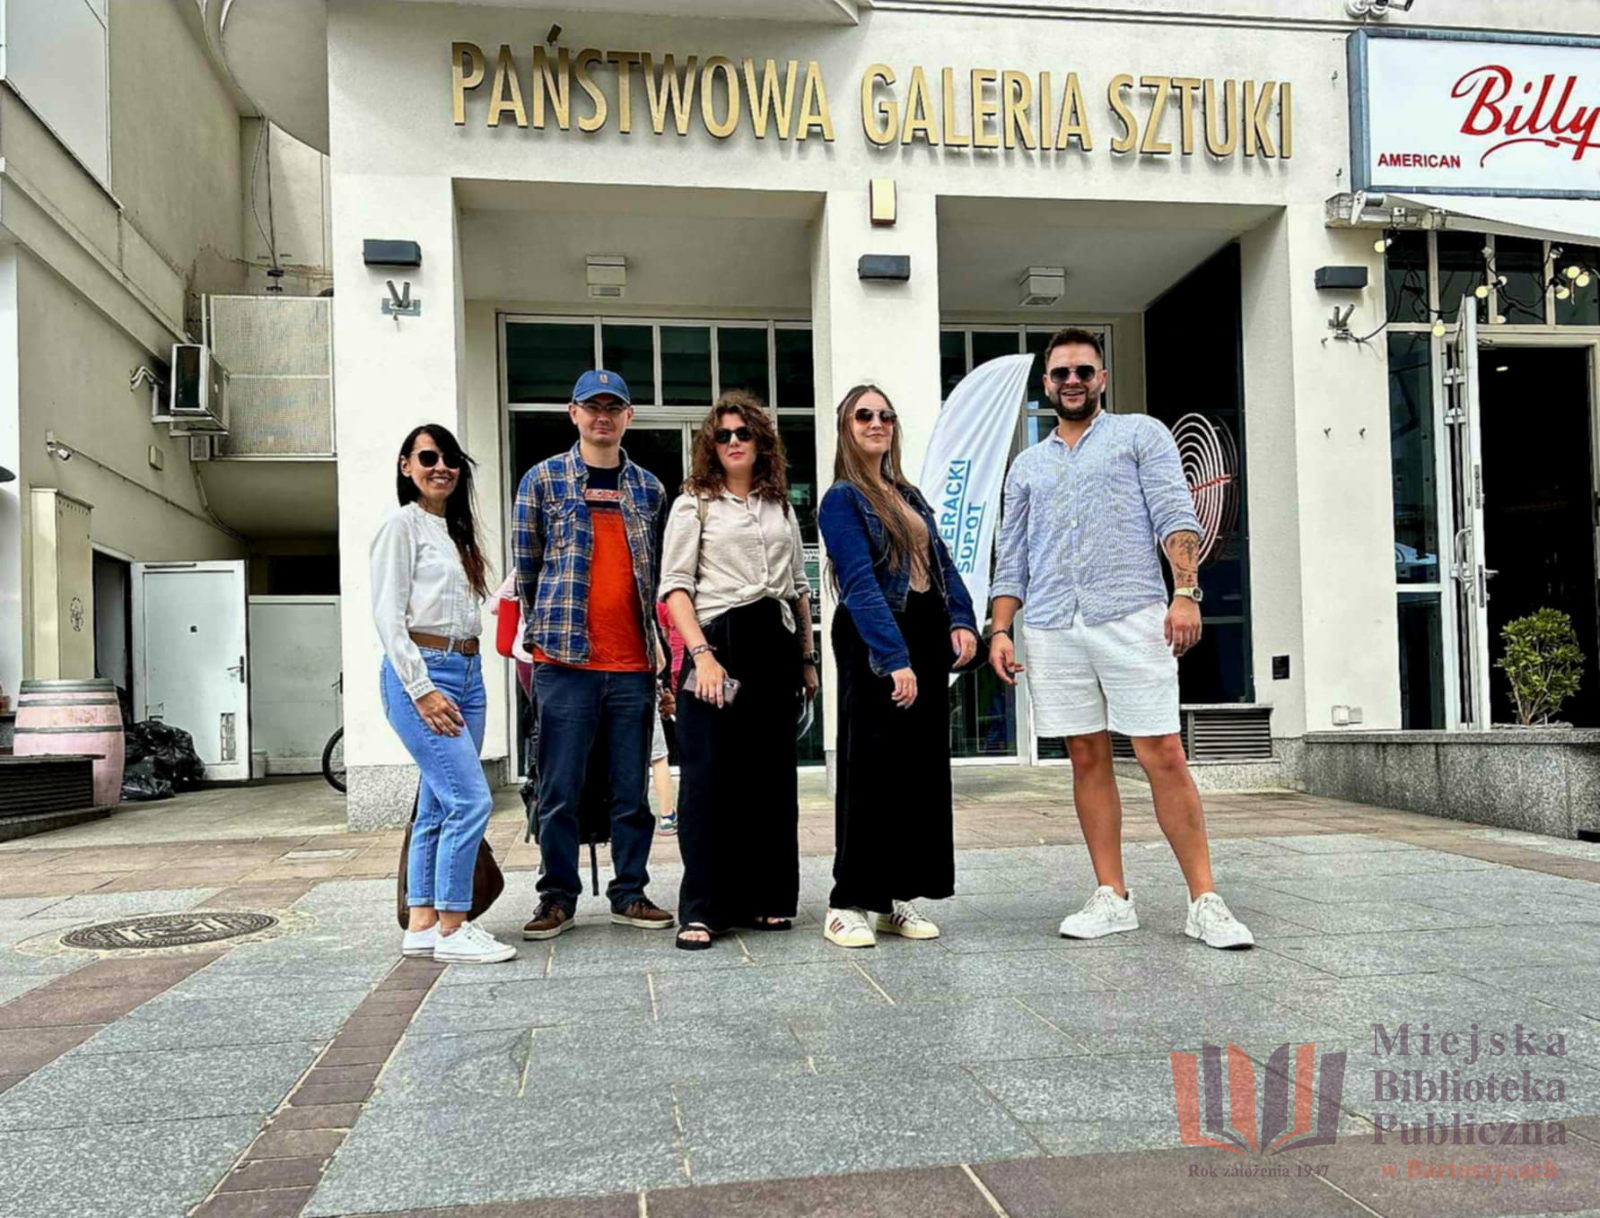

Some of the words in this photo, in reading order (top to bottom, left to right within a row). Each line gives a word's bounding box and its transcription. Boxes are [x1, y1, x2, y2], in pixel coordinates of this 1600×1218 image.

[452, 24, 835, 141] PAŃSTWOWA
[860, 63, 1093, 151] GALERIA
[1107, 73, 1293, 159] SZTUKI
[1450, 64, 1600, 161] Billy
[1377, 153, 1461, 168] AMERICAN
[940, 459, 966, 554] ERACKI
